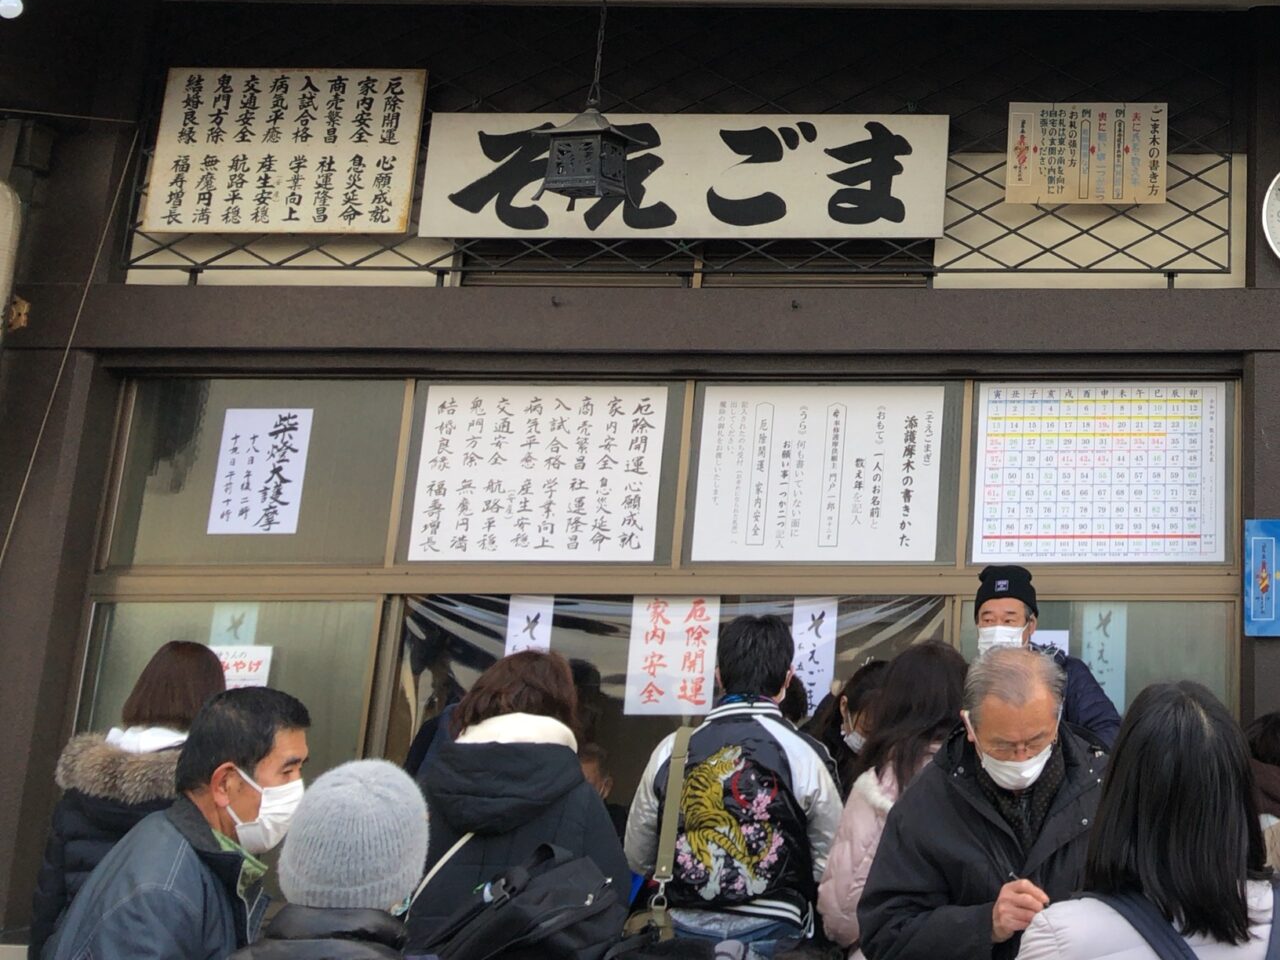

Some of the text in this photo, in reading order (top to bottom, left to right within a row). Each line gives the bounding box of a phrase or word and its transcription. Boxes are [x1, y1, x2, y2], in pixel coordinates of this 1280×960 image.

[162, 76, 204, 224] 結婚良縁 福寿増長
[193, 74, 233, 224] 鬼門方除 無魔円満
[221, 75, 262, 224] 交通安全 航路平穏
[251, 76, 289, 223] 病気平癒 産生安穏
[282, 76, 320, 222] 入試合格 学業向上
[312, 76, 348, 223] 商売繁昌 社運隆昌
[338, 77, 378, 225] 家内安全 息災延命
[368, 77, 404, 223] 厄除開運 心願成就
[900, 416, 918, 547] 添護摩木の書きかた
[640, 598, 671, 705] 家内安全
[678, 598, 711, 706] 厄除開運
